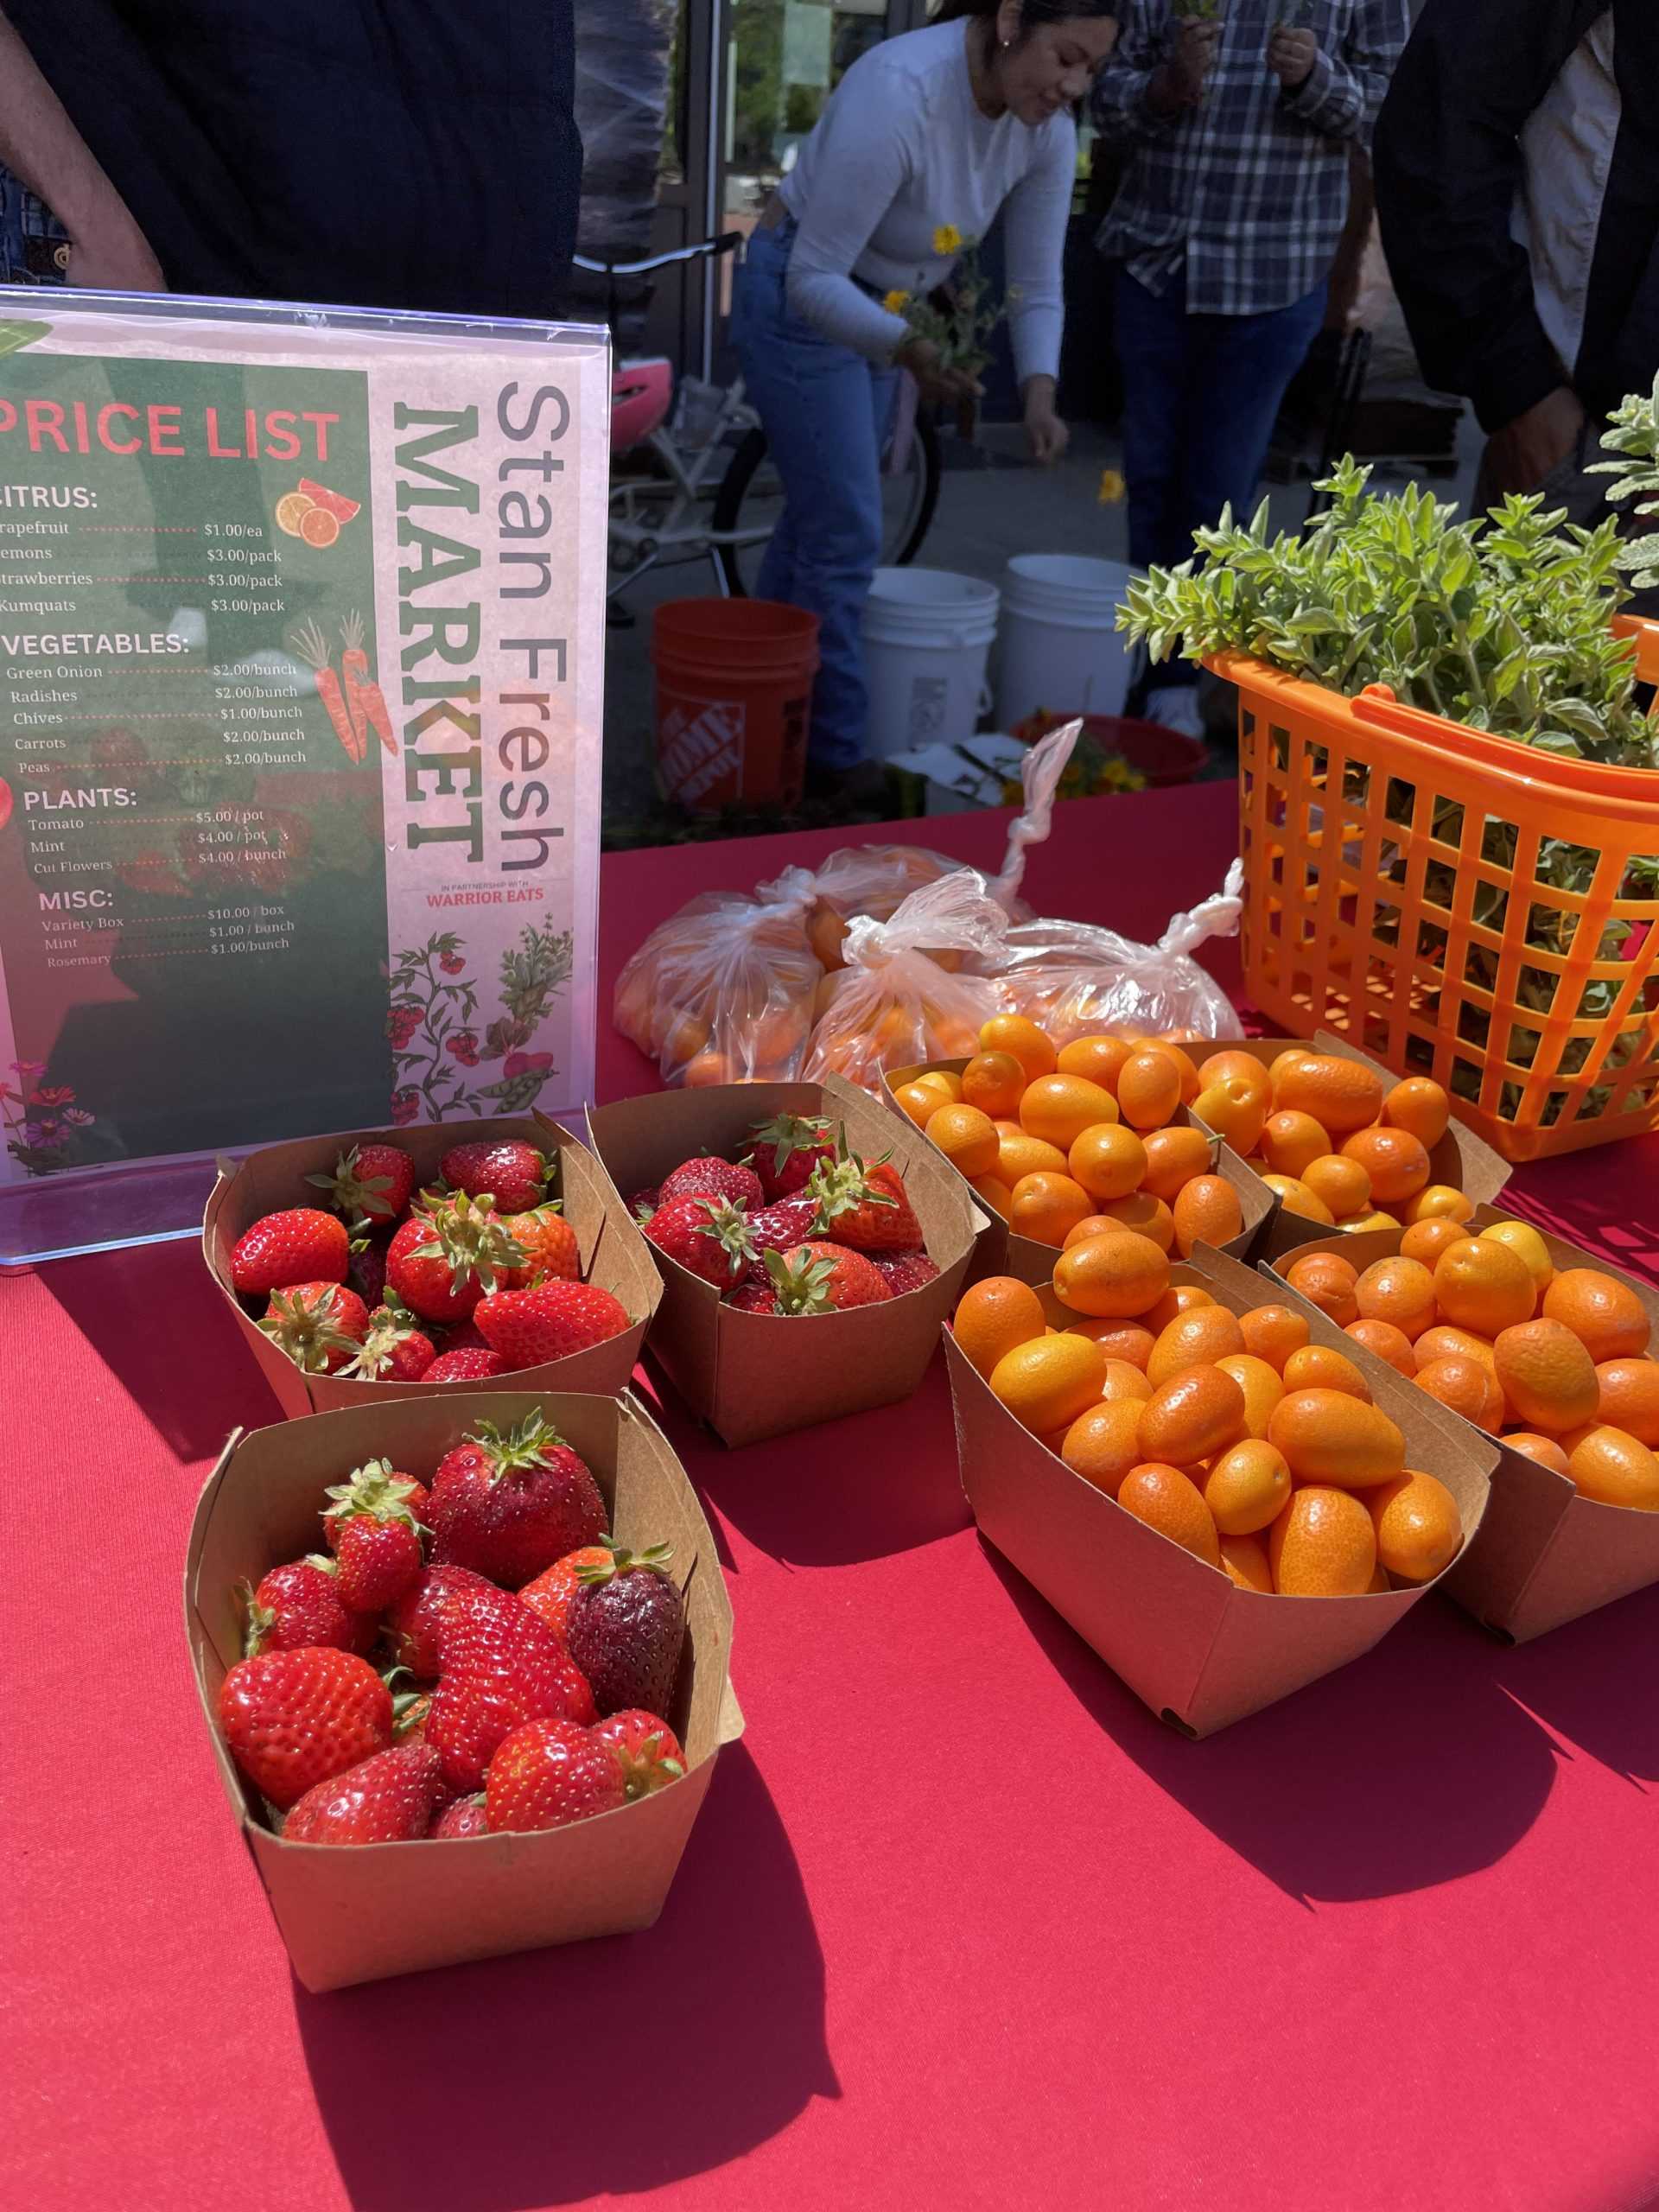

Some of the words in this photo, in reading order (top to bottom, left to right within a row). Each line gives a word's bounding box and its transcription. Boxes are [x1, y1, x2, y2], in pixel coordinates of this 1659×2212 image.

[206, 407, 340, 462] LIST
[0, 486, 97, 508] ITRUS:
[497, 381, 570, 599] Stan
[0, 521, 69, 537] rapefruit
[204, 524, 263, 539] $1.00/ea
[0, 548, 53, 560] emons
[207, 549, 283, 565] $3.00/pack
[0, 571, 93, 585] trawberries
[208, 574, 283, 590] $3.00/pack
[211, 598, 285, 614] $3.00/pack
[393, 402, 484, 862] MARKET
[1, 633, 189, 656] VEGETABLES:
[7, 667, 53, 680] Green
[57, 665, 103, 678] Onion
[213, 664, 297, 677] $2.00/bunch
[11, 690, 78, 703] Radishes
[214, 685, 298, 699] $2.00/bunch
[13, 712, 63, 725] Chives
[220, 707, 302, 721] $1.00/bunch
[15, 738, 67, 750] Carrots
[223, 728, 305, 743] $2.00/bunch
[19, 762, 50, 773] Peas
[225, 751, 307, 766] $2.00/bunch
[498, 639, 567, 871] Fresh
[23, 787, 137, 810] PLANTS:
[28, 818, 84, 831] Tomato
[195, 810, 232, 823] $5.00
[243, 810, 264, 824] pot
[30, 841, 66, 854] Mint
[198, 831, 233, 844] $4.00
[244, 830, 266, 844] pot
[60, 861, 112, 873] Flowers
[199, 850, 234, 865] $4.00
[39, 889, 113, 911] MISC:
[426, 891, 502, 907] WARRIOR
[506, 887, 543, 903] EATS
[41, 918, 93, 932] Variety
[98, 917, 124, 928] Box
[207, 907, 250, 921] $10.00
[260, 905, 284, 917] box
[45, 938, 77, 951] Mint
[209, 925, 245, 938] $1.00
[255, 920, 295, 934] bunch
[48, 954, 111, 969] Rosemary
[211, 938, 289, 955] $1.00/bunch
